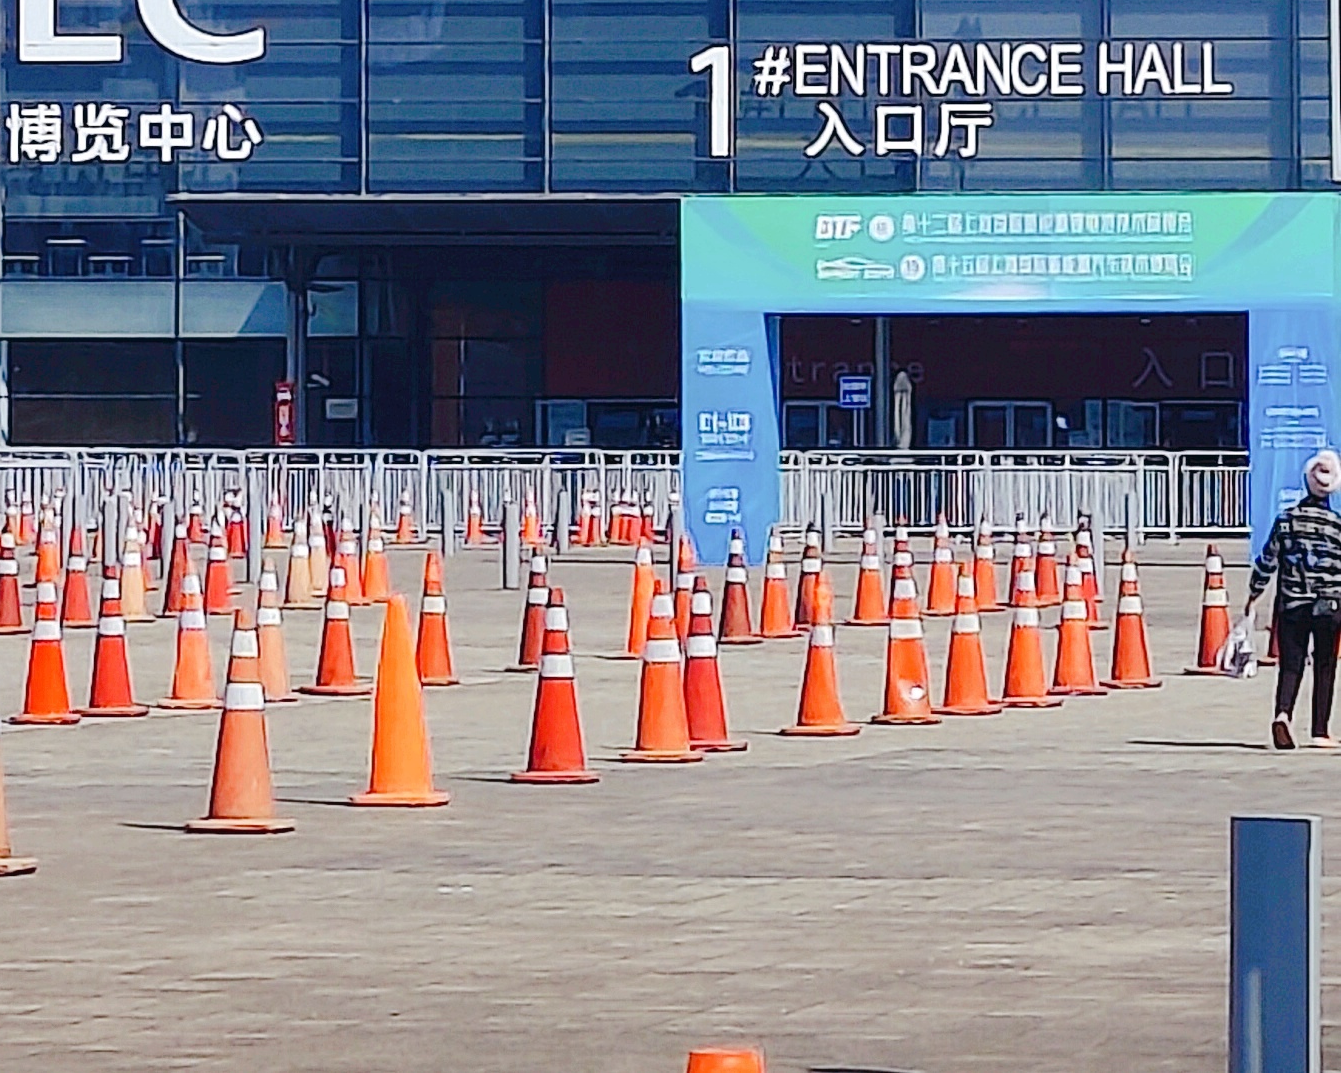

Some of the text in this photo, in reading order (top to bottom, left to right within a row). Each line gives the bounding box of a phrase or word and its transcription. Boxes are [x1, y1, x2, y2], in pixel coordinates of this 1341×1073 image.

[690, 45, 733, 158] 1
[1097, 42, 1233, 96] HALL
[804, 103, 993, 158] 入口厅
[1132, 347, 1235, 389] 入口
